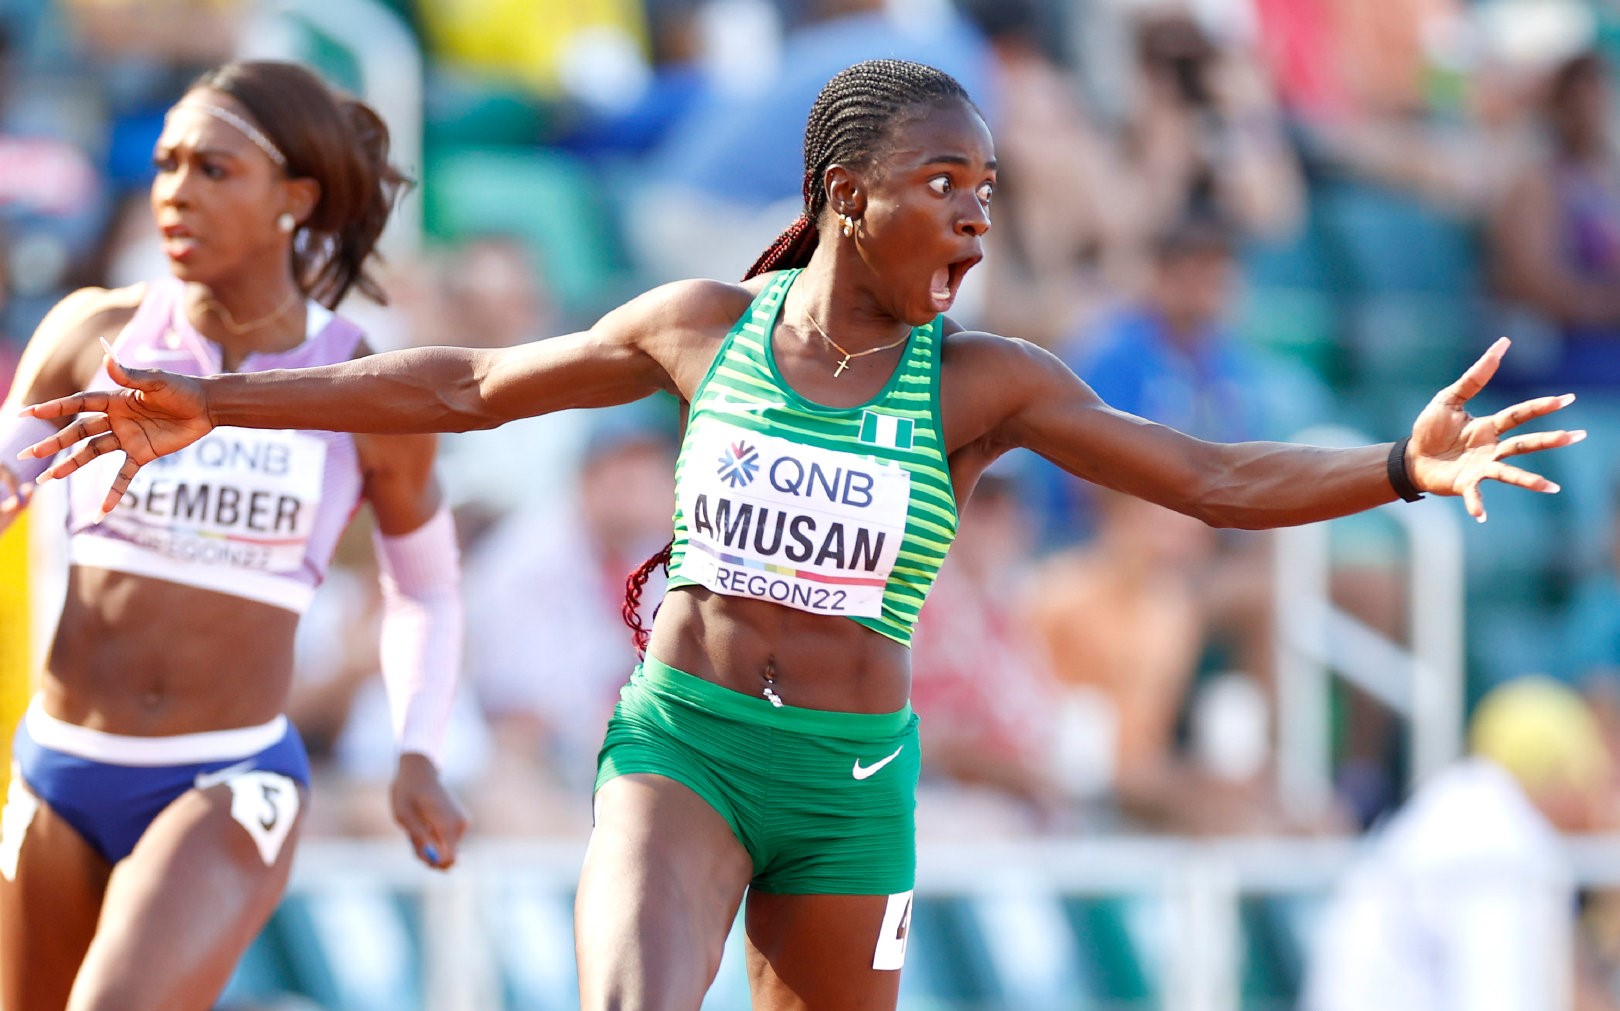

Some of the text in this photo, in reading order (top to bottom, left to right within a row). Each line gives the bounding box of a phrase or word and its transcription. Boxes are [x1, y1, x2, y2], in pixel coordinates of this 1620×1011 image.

[196, 436, 289, 475] QNB
[769, 456, 874, 507] QNB
[695, 494, 886, 572] AMUSAN
[708, 563, 847, 610] REGON22
[259, 784, 280, 831] 5
